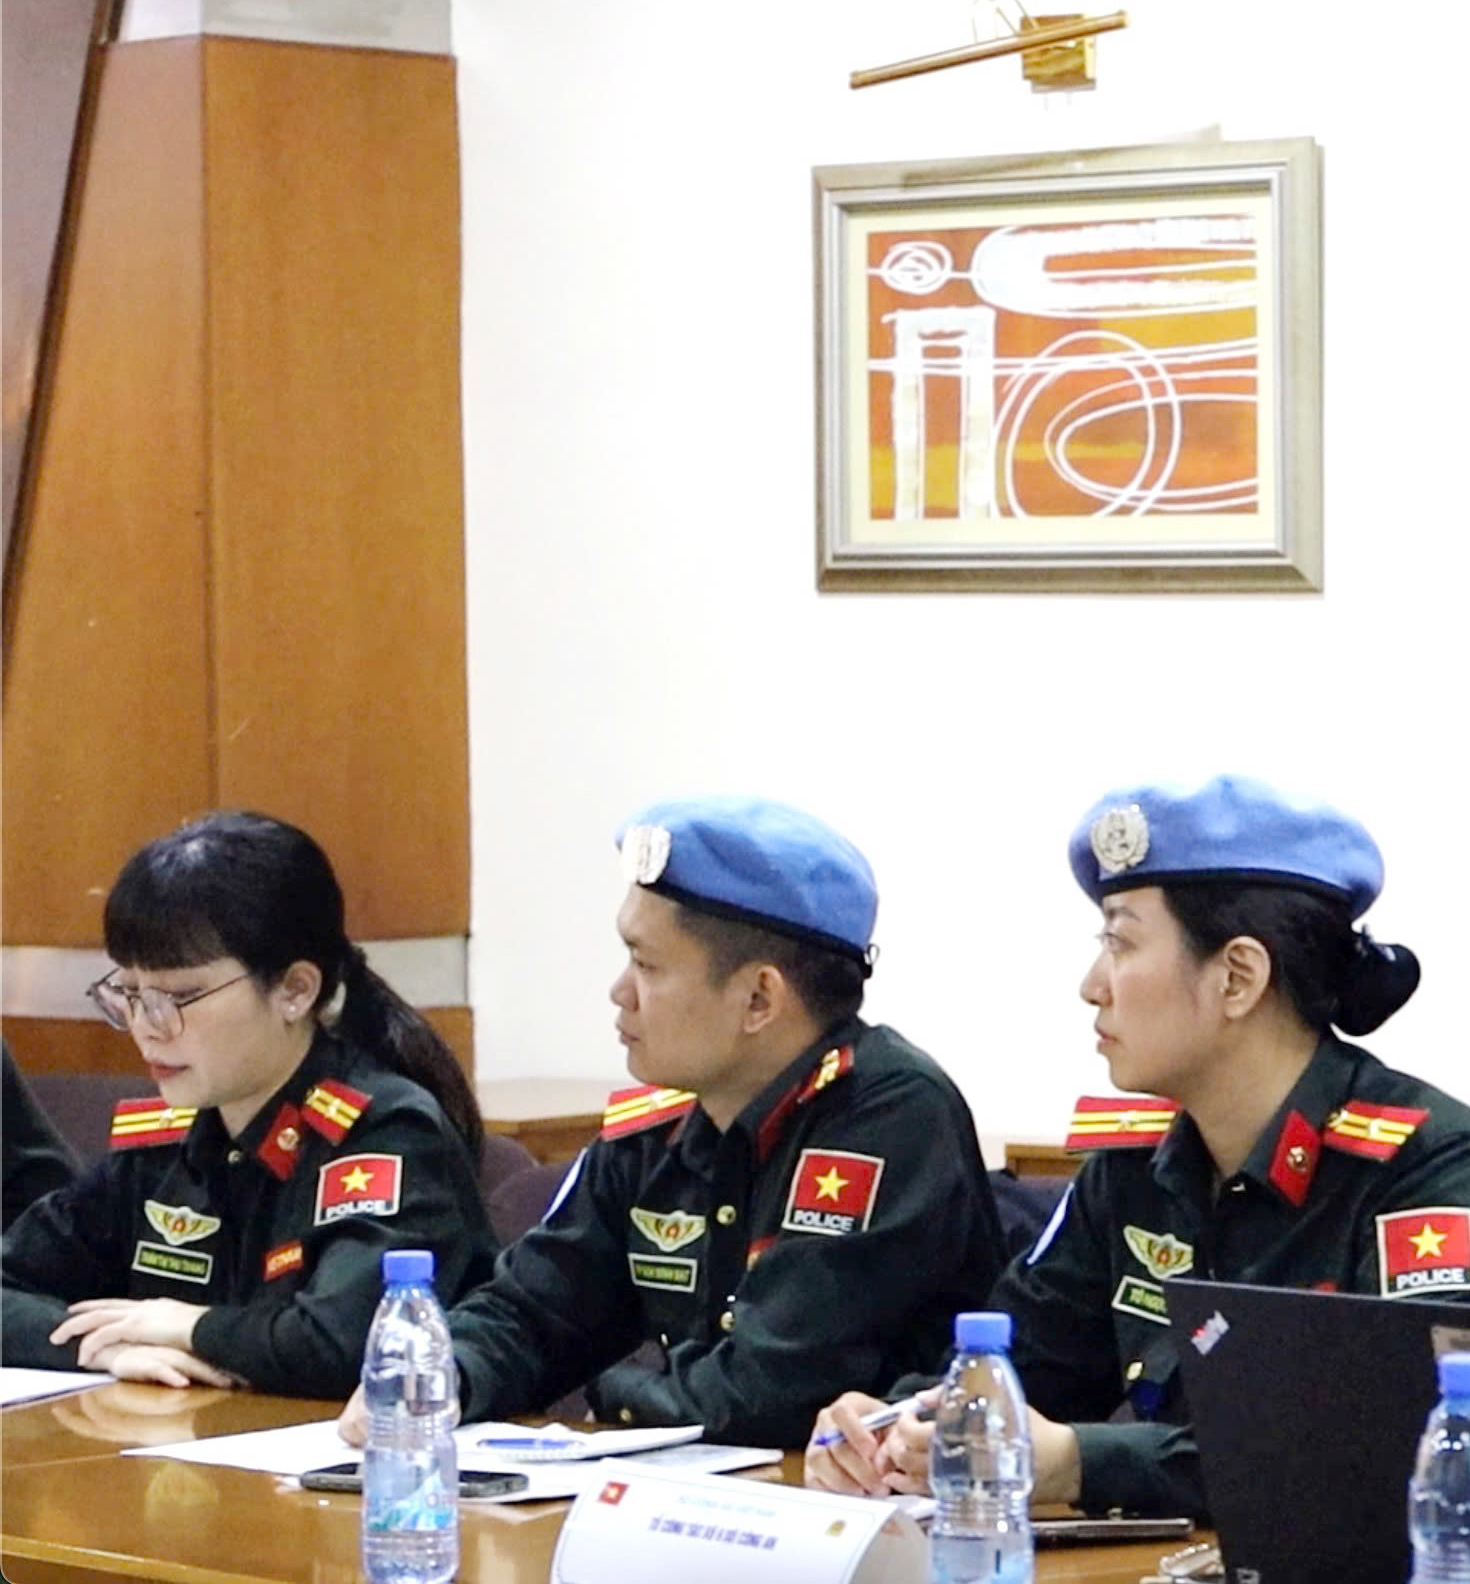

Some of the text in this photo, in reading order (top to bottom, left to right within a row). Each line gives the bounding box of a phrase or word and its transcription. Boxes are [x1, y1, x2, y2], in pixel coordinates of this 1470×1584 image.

[325, 1200, 387, 1219] POLICE
[794, 1209, 855, 1231] POLICE
[1396, 1268, 1464, 1290] POLICE
